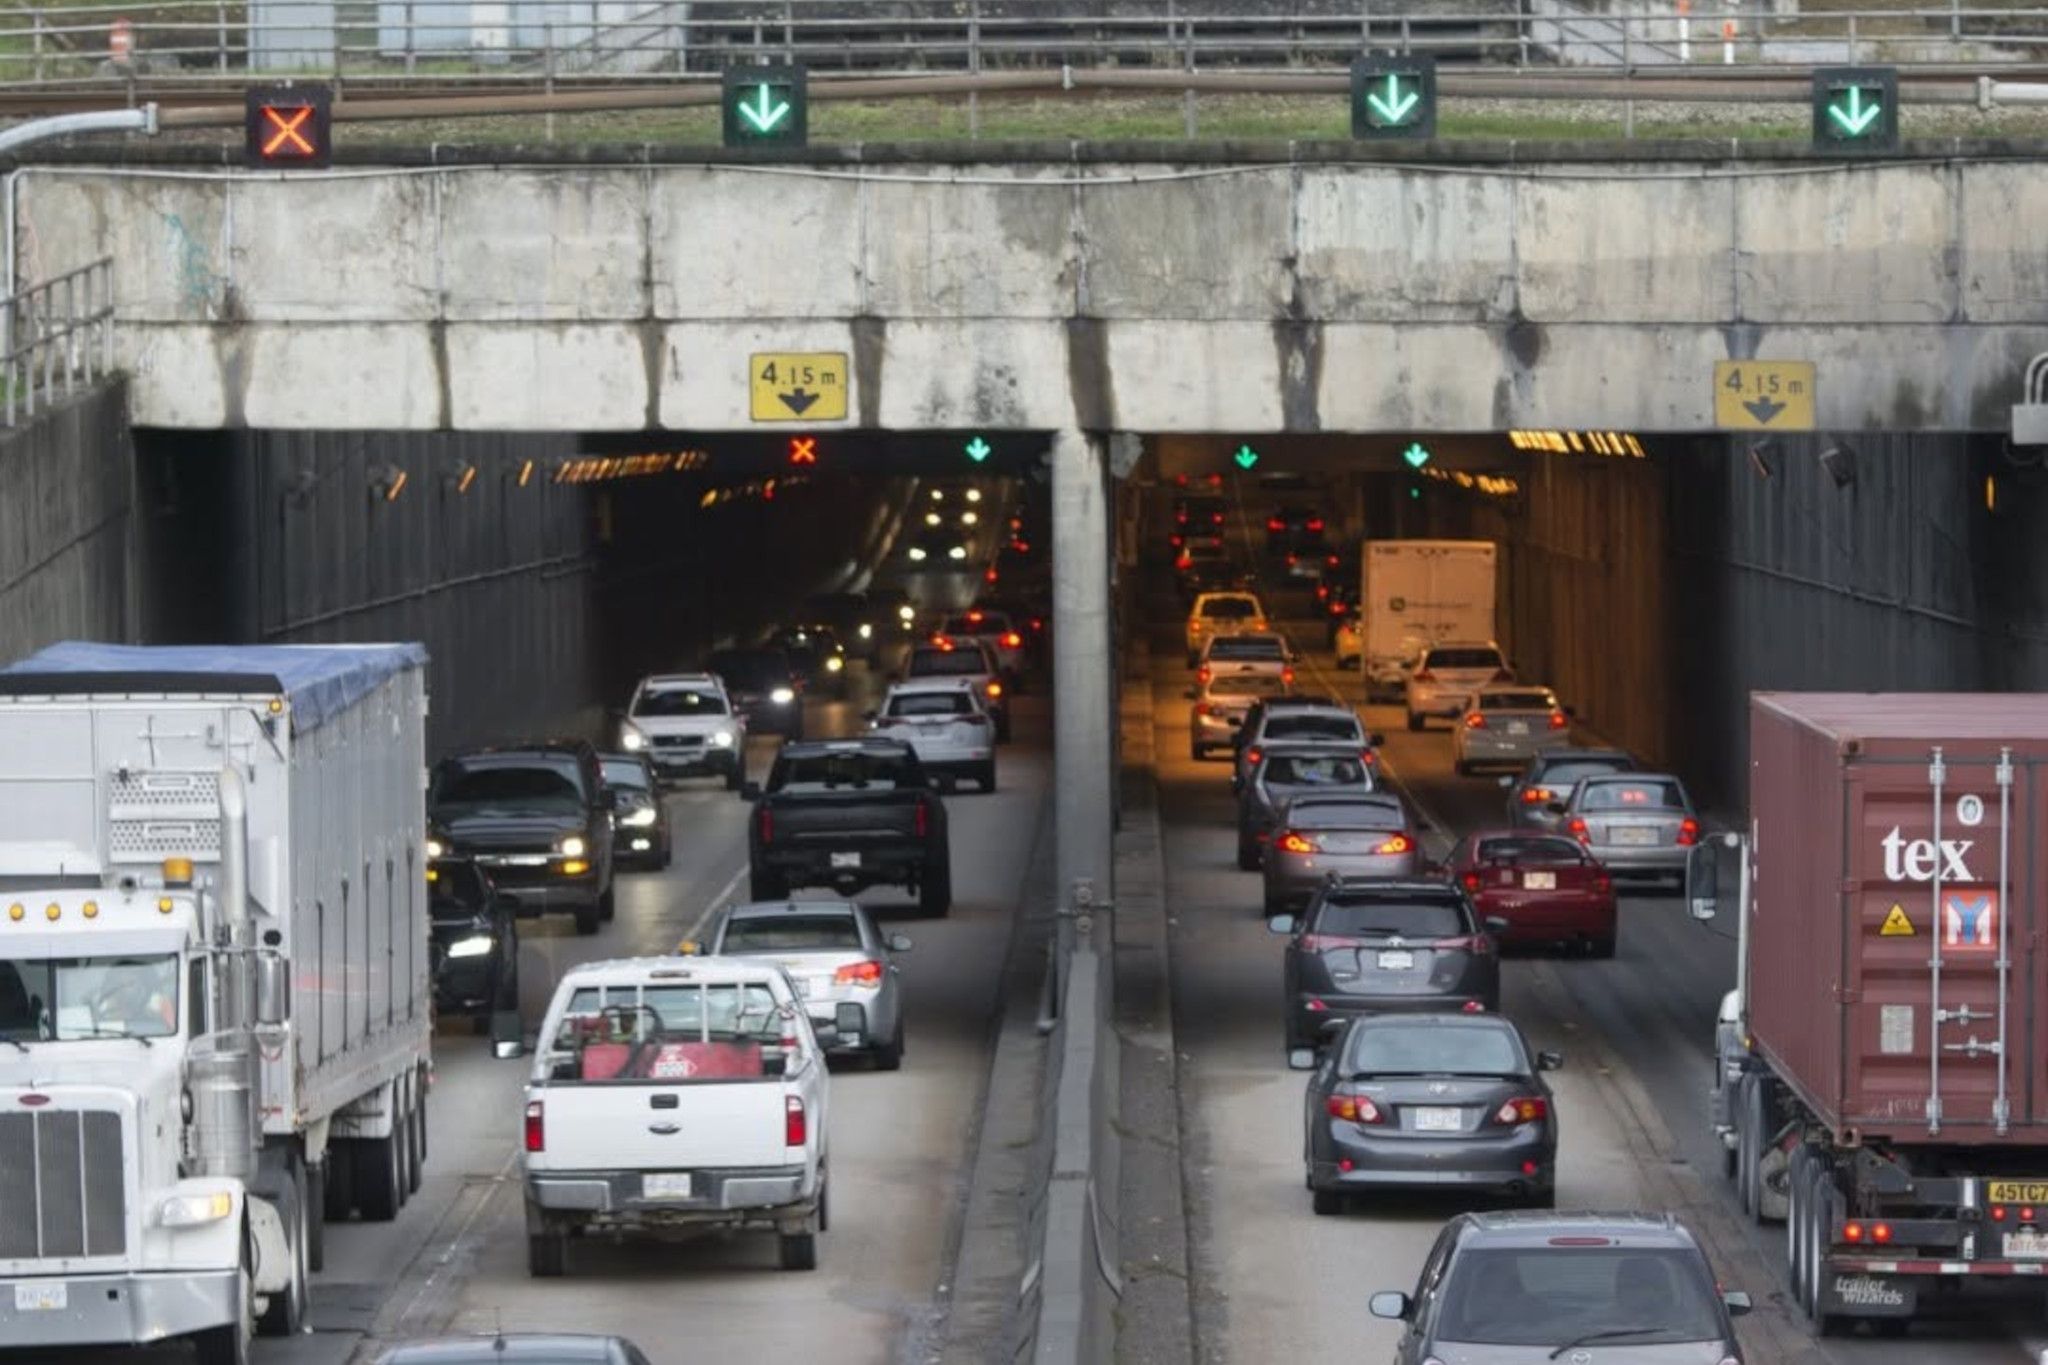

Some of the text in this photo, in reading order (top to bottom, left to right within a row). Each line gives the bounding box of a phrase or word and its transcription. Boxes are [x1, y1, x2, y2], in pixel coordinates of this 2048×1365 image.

[761, 361, 836, 385] 4.15 m
[1726, 368, 1804, 394] 4.15 m
[1881, 825, 1975, 882] tex
